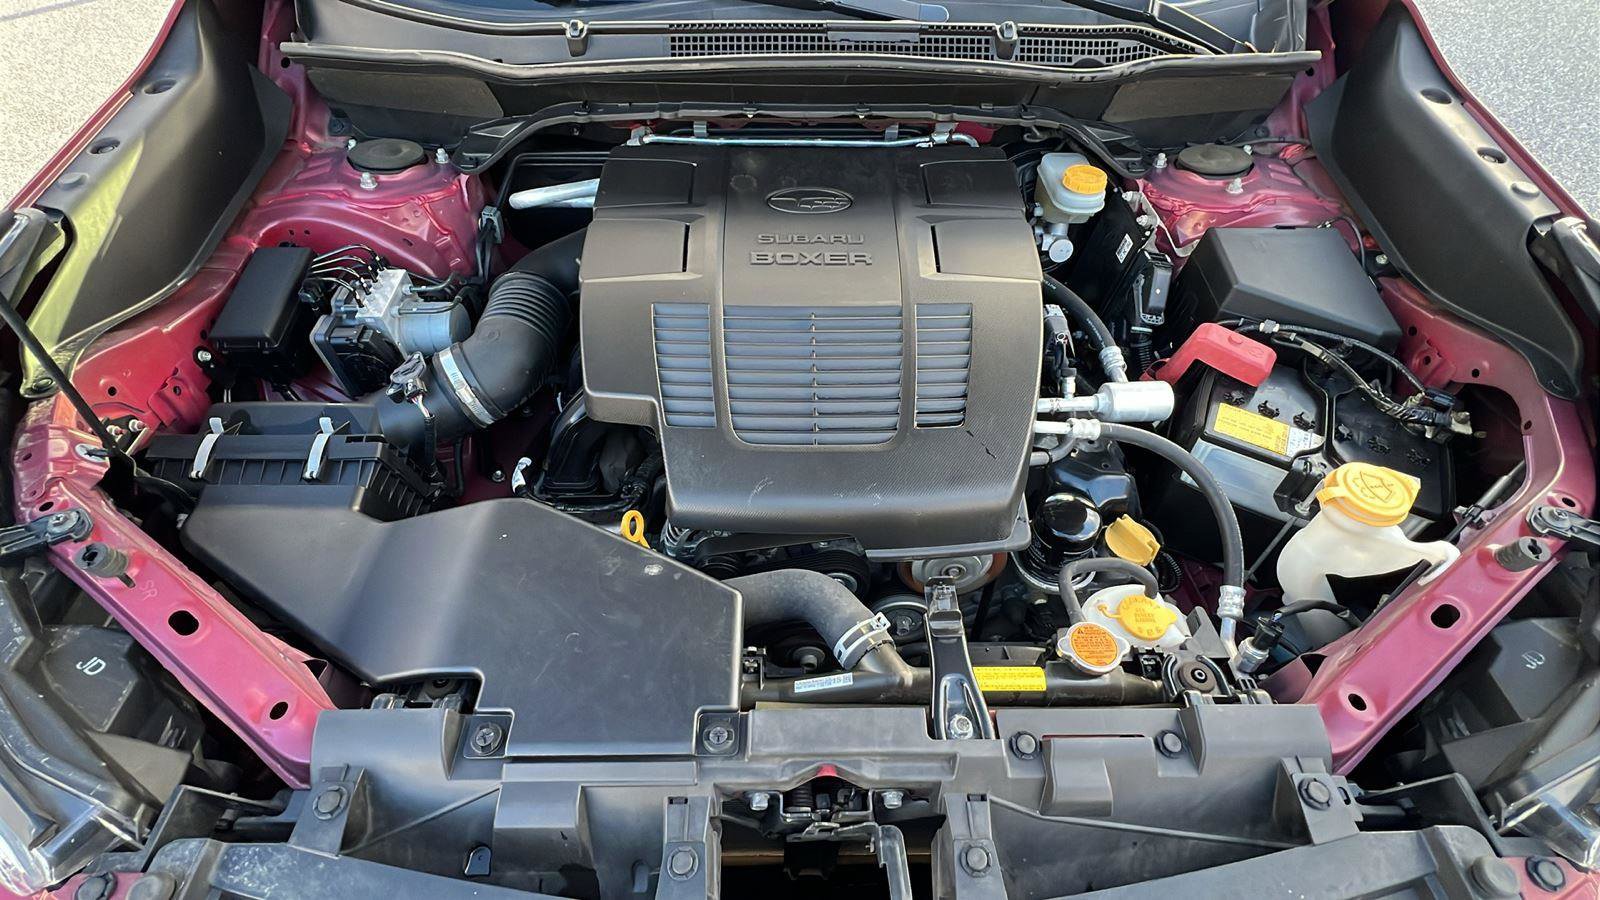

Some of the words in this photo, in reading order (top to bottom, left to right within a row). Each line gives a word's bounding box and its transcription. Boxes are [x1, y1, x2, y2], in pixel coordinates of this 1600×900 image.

[757, 233, 864, 245] SUBARU
[750, 252, 873, 266] BOXER
[76, 656, 106, 676] JD
